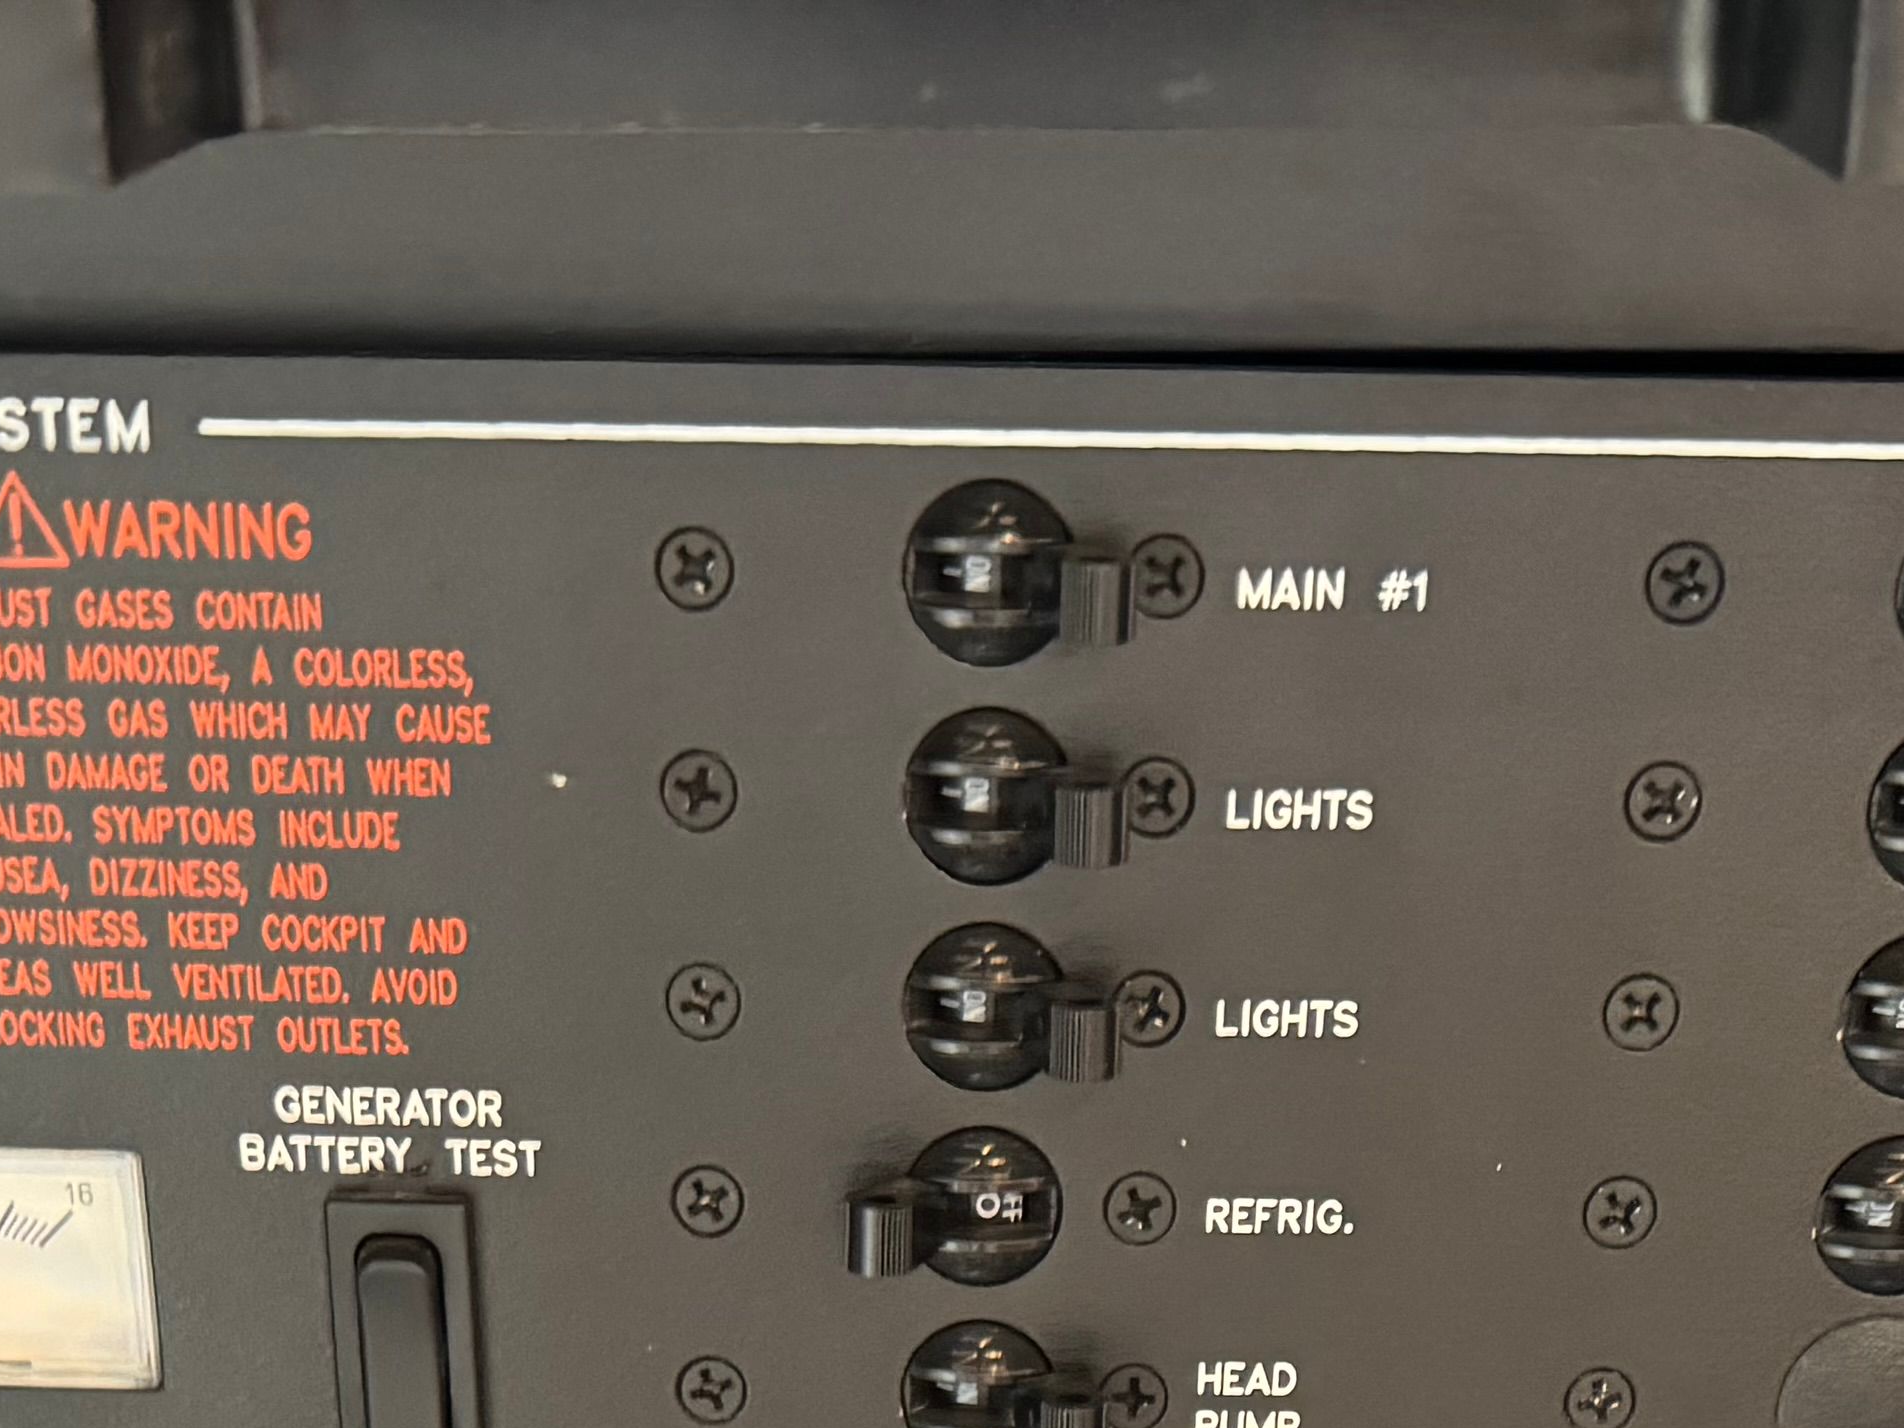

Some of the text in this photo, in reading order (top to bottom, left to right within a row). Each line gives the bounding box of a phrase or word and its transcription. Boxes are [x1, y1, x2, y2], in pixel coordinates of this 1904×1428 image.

[63, 499, 313, 562] WARNING
[75, 588, 175, 632] GASES
[195, 590, 324, 632] CONTAIN
[1236, 565, 1429, 613] MAIN #1
[66, 643, 231, 694] MONOXIDE,
[251, 648, 274, 686] A
[293, 647, 475, 698] COLORLESS,
[107, 699, 170, 740] GAS
[189, 700, 289, 741] WHICH
[309, 703, 373, 743] MAY
[395, 703, 493, 746] CAUSE
[46, 751, 169, 794] DAMAGE
[188, 754, 230, 794] OR
[251, 754, 346, 796] DEATH
[366, 757, 453, 799] WHEN
[92, 805, 257, 848] SYMPTOMS
[279, 810, 401, 853] INCLUDE
[1225, 787, 1374, 831] LIGHTS
[1214, 998, 1359, 1039] LIGHTS
[272, 1084, 503, 1128] GENERATOR
[238, 1132, 542, 1178] BATTERY TEST
[64, 1182, 94, 1207] 16
[1205, 1197, 1354, 1235] REFRIG.
[1196, 1360, 1298, 1397] HEAD
